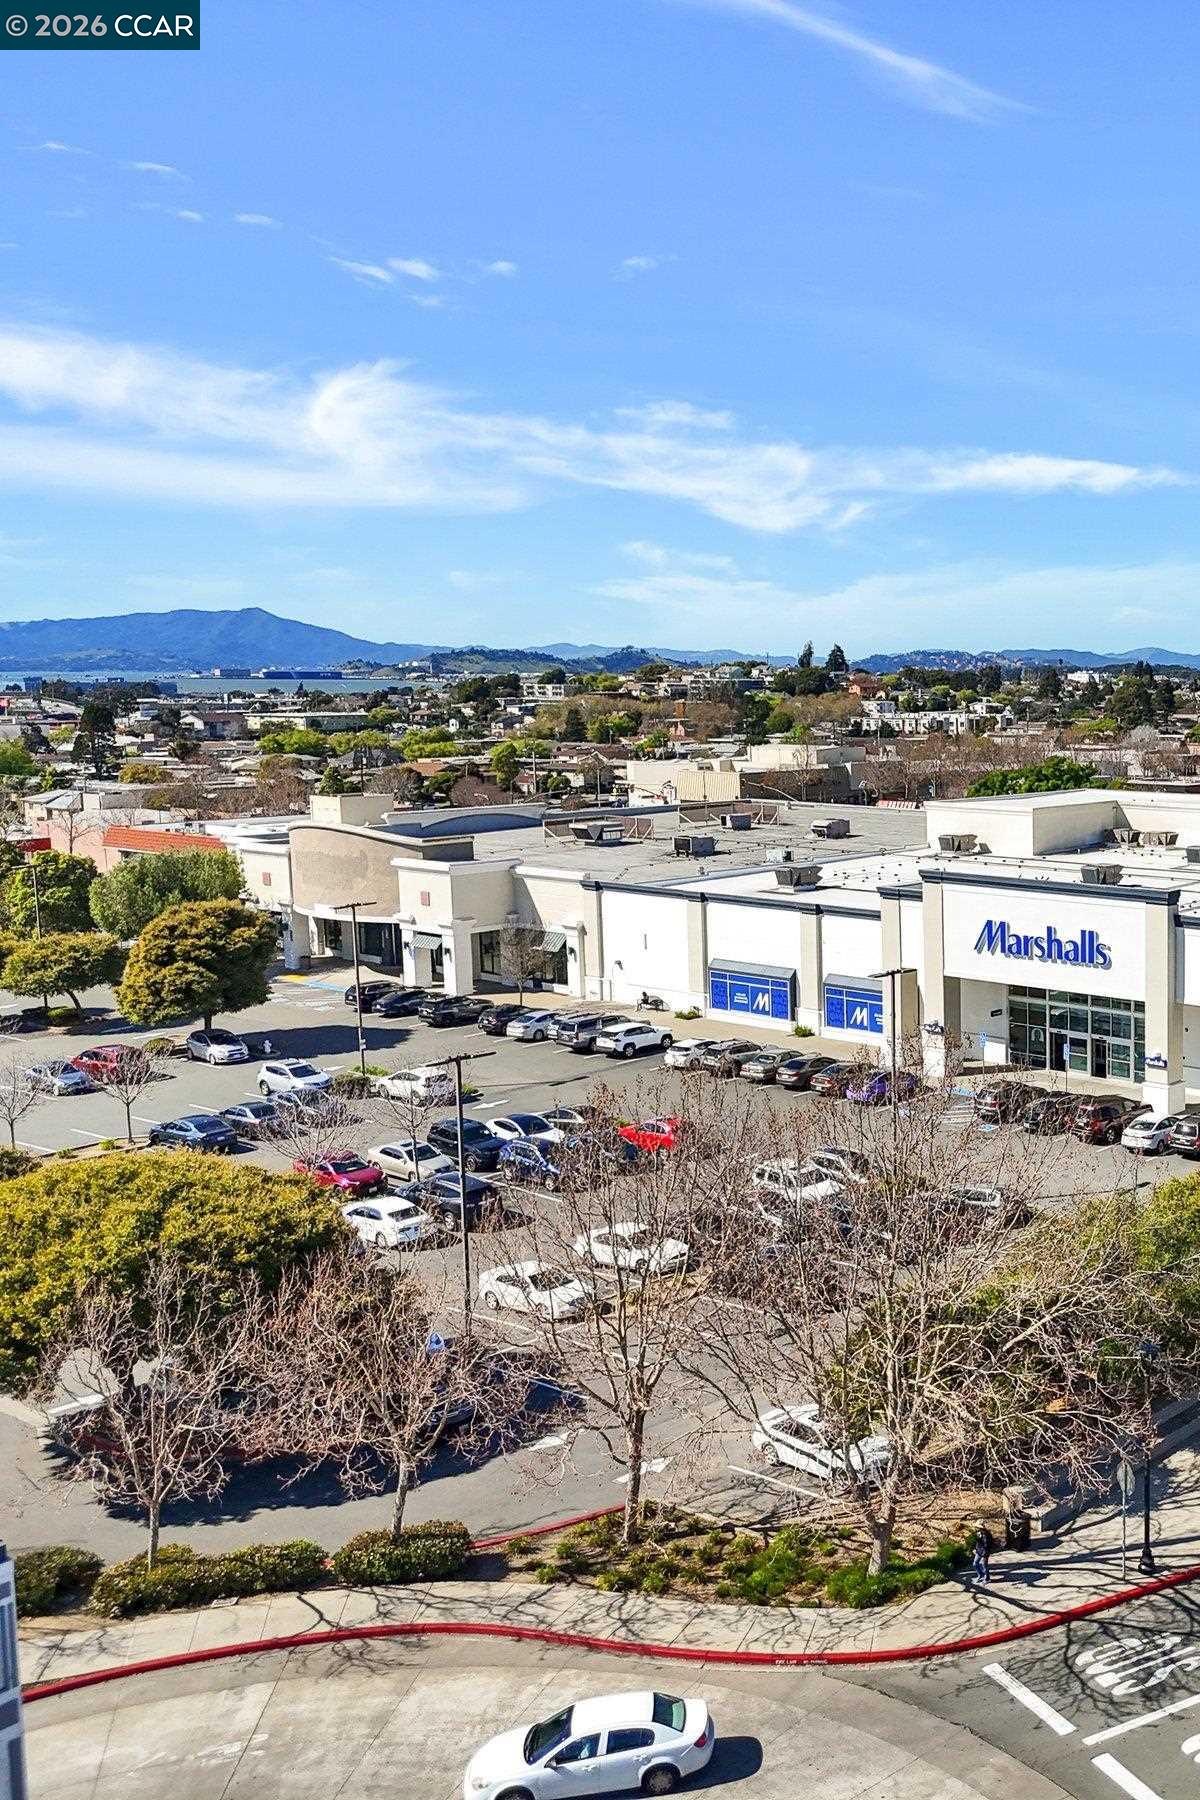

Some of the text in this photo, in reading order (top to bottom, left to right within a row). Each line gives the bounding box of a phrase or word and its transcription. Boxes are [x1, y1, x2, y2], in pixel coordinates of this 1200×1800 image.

[974, 919, 1112, 969] Marshalls
[752, 991, 770, 1011] M
[850, 1006, 868, 1027] M
